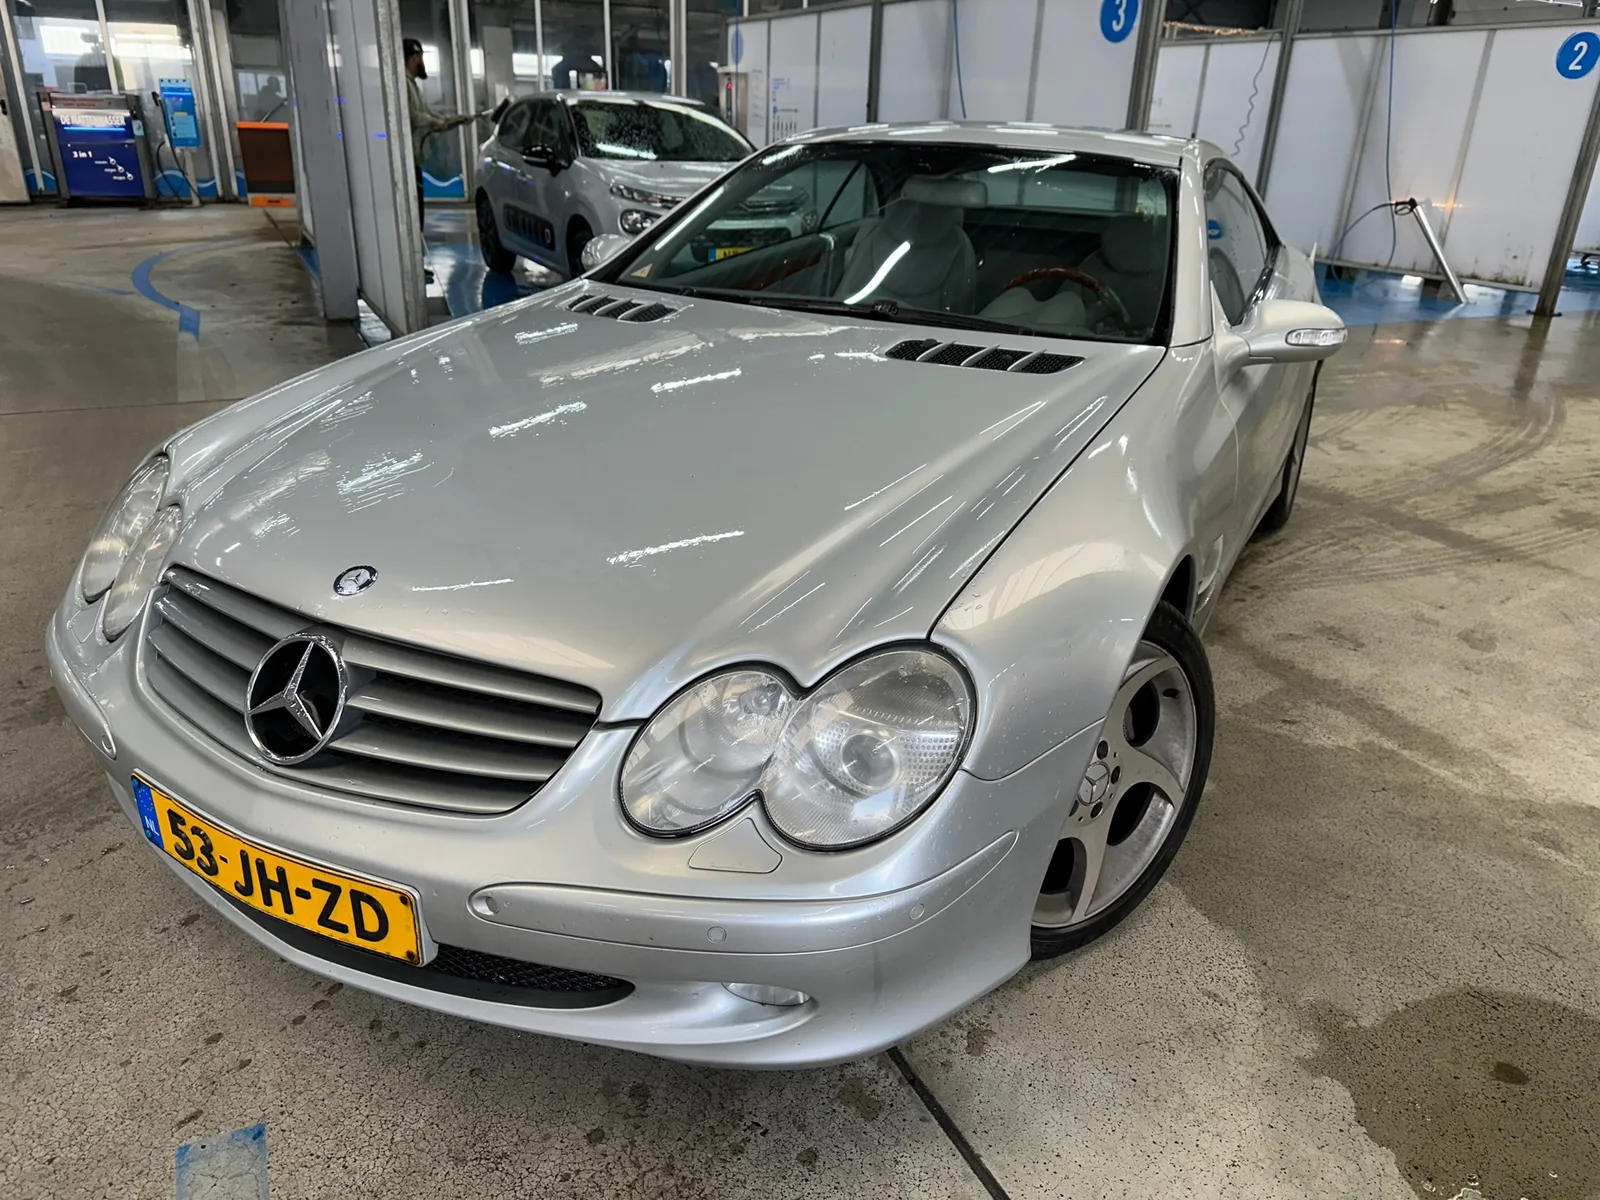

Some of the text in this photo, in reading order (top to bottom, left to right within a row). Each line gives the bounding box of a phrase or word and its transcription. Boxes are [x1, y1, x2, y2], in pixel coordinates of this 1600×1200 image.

[1112, 0, 1127, 32] 3
[1568, 41, 1588, 70] 2
[145, 808, 389, 942] NL 53-JH-ZD
